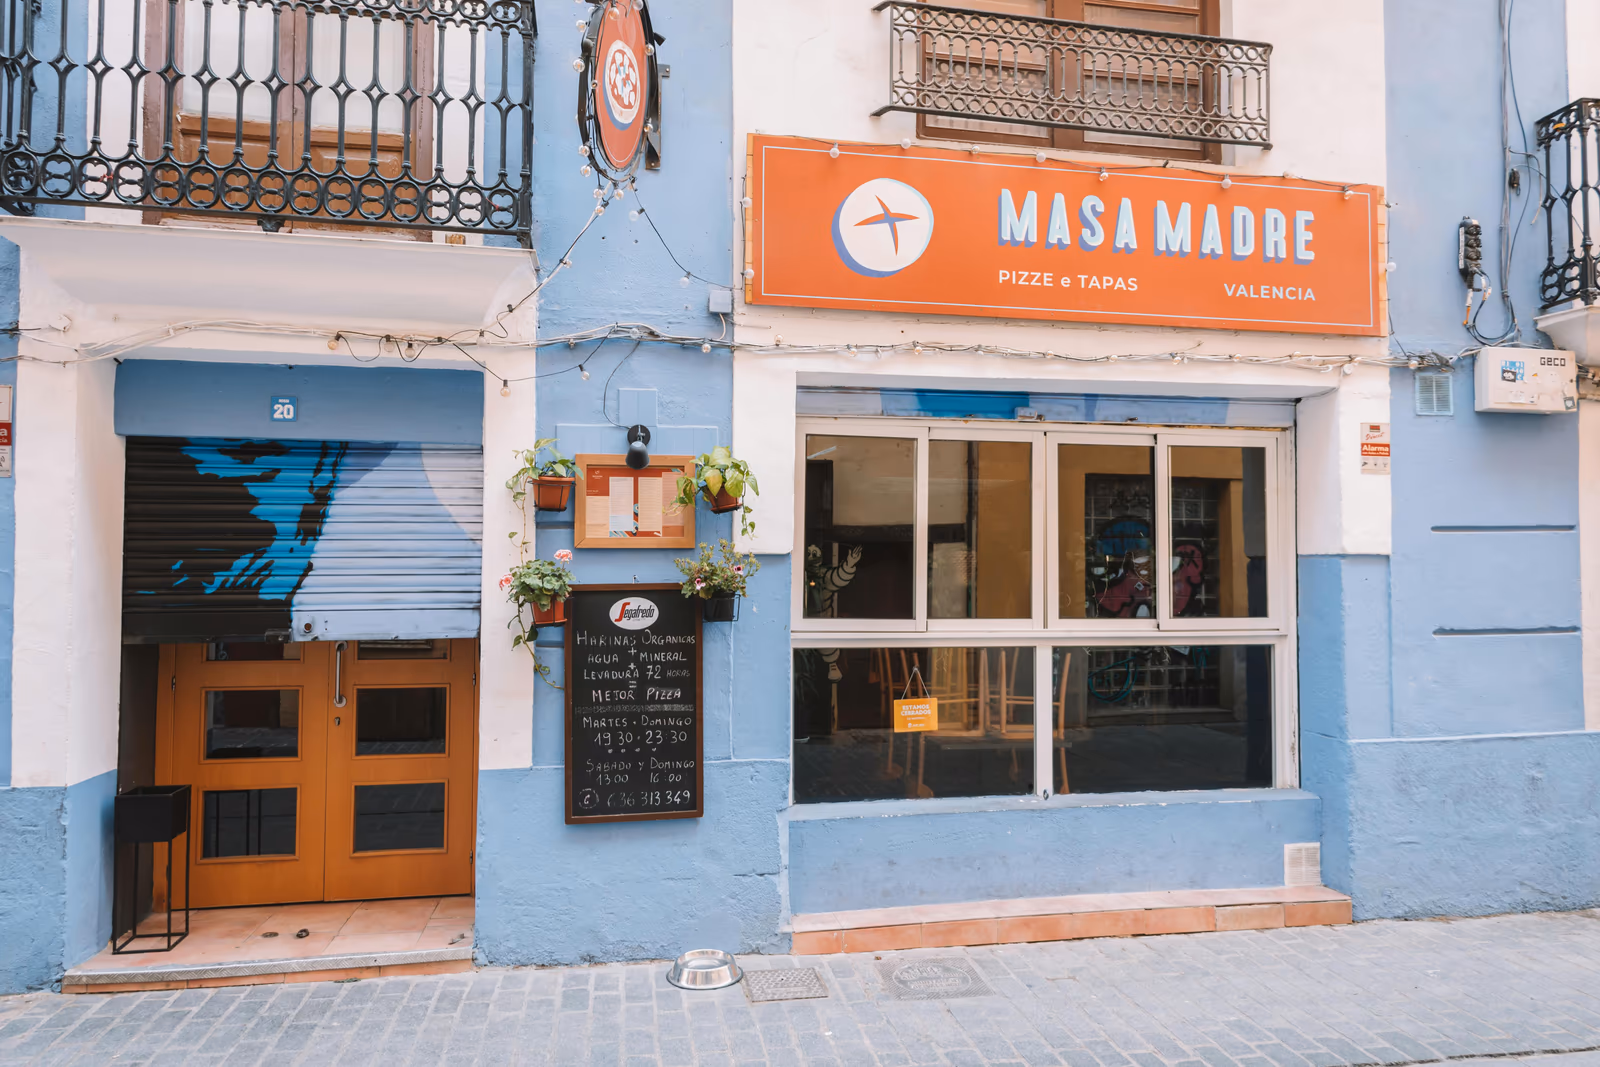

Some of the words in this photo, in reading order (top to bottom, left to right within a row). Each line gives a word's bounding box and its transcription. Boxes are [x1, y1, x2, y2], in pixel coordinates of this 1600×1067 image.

[998, 188, 1137, 254] MASA
[1153, 199, 1315, 265] MADRE
[998, 270, 1054, 287] PIZZE
[1060, 275, 1072, 288] e
[1077, 275, 1138, 291] TAPAS
[1224, 283, 1316, 301] VALENCIA
[273, 404, 294, 419] 20
[1362, 444, 1389, 452] Alarma
[614, 602, 655, 622] Segafredo
[642, 629, 696, 646] ORGANICAS
[588, 654, 619, 664] AGUA
[640, 652, 687, 662] MINERAL
[584, 669, 640, 680] LEVADURA
[646, 665, 661, 680] 72
[646, 687, 681, 701] PIZZA
[583, 716, 628, 729] MARTES
[641, 715, 692, 727] DOMINGO
[585, 759, 631, 772] SABADO
[650, 757, 695, 769] DOMINGO
